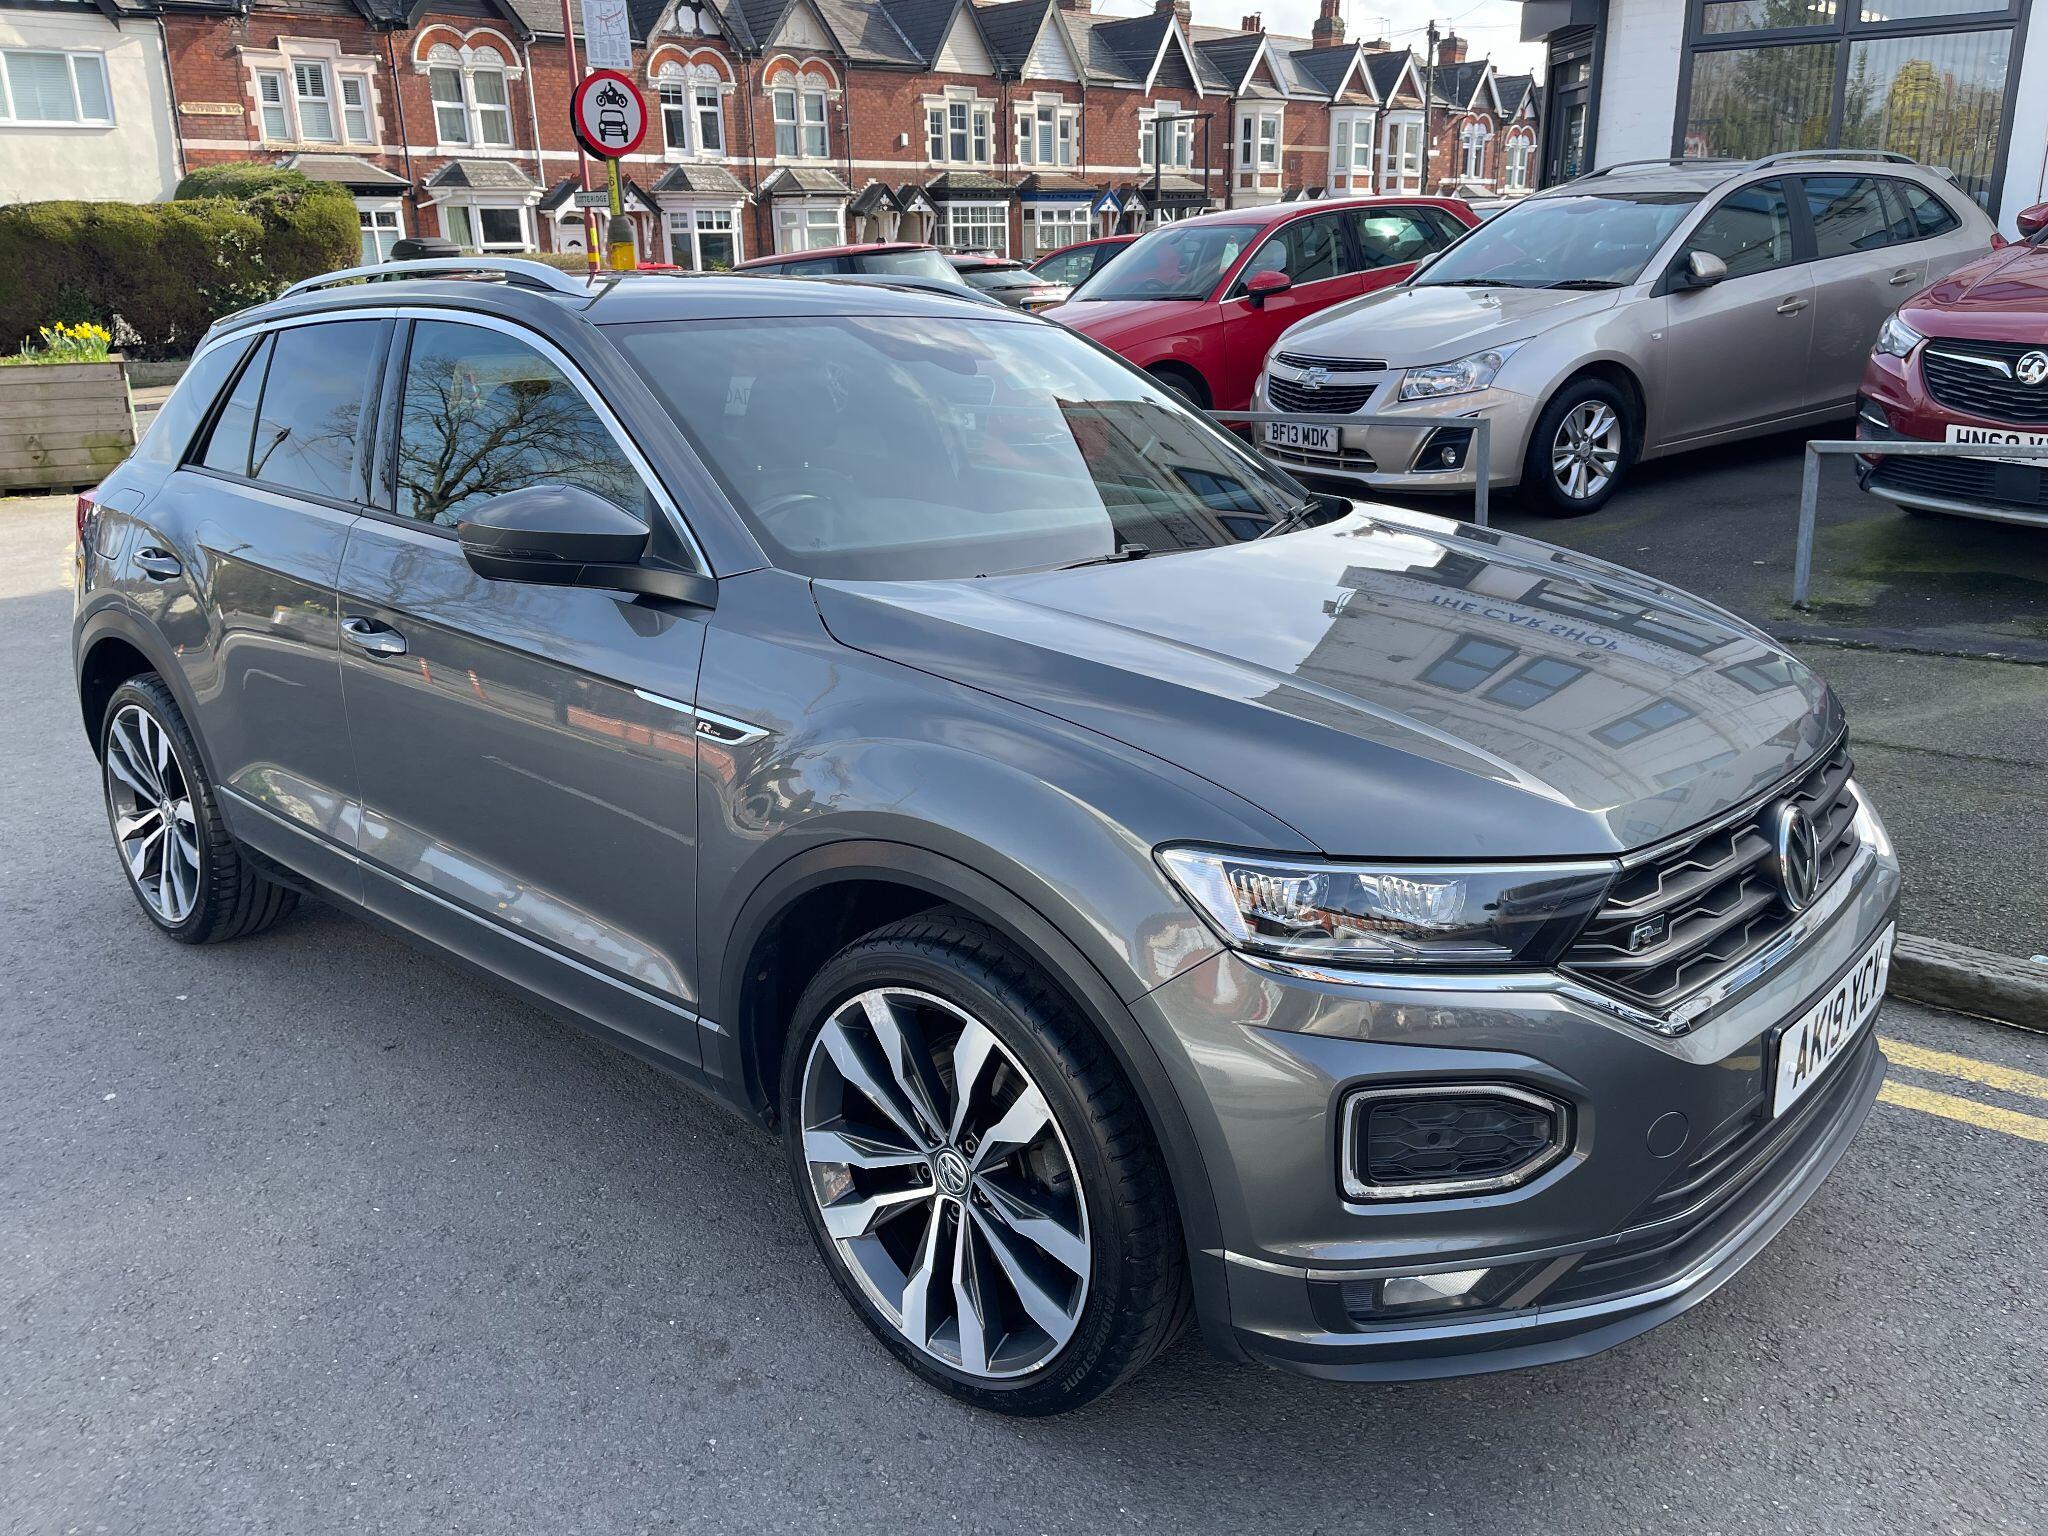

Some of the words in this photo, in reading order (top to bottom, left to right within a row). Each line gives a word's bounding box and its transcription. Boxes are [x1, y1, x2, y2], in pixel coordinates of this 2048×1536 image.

[1271, 423, 1298, 443] BF13
[1302, 426, 1329, 448] MDK
[1792, 986, 1846, 1090] AK19
